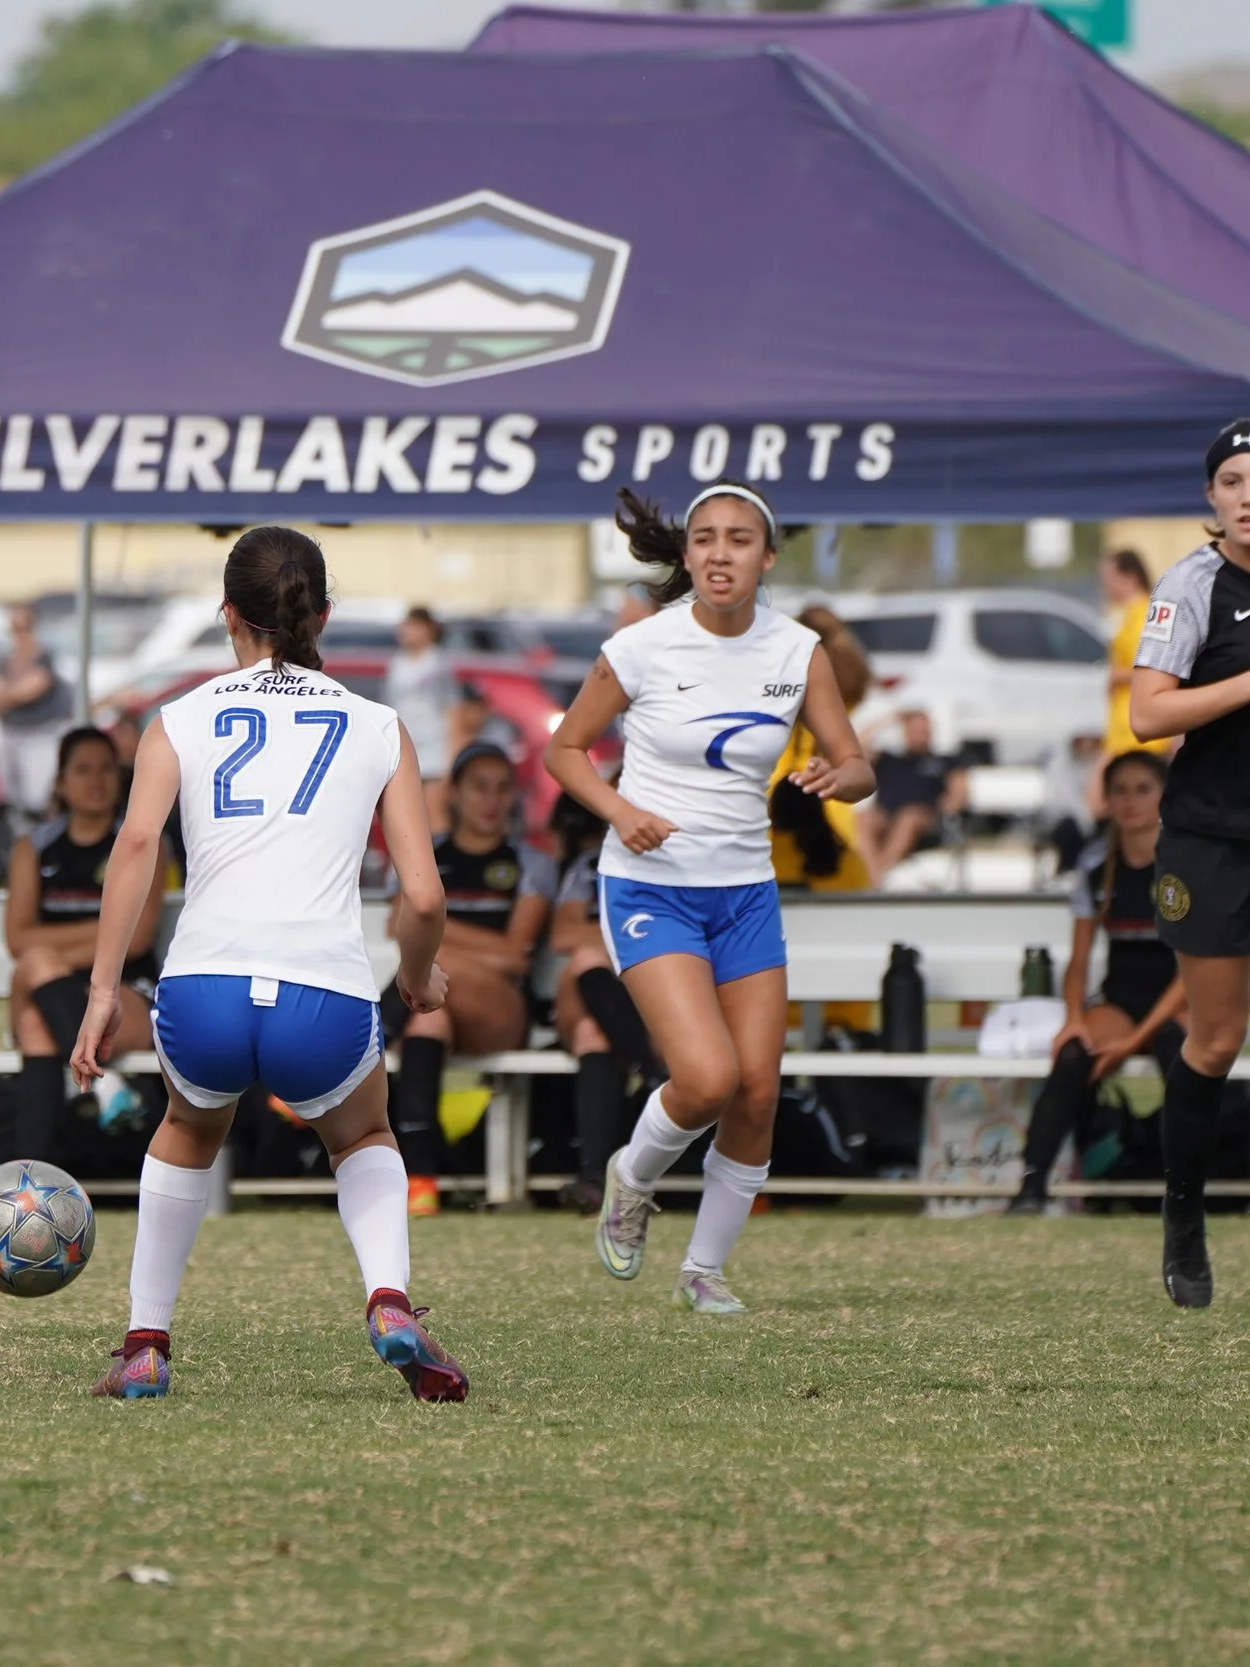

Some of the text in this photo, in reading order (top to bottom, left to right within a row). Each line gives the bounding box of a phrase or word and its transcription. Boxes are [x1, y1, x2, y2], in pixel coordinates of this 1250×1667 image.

[576, 423, 896, 483] SPORTS
[263, 675, 308, 685] SURF
[214, 683, 343, 697] LOS ANGELES
[762, 683, 805, 697] SURF
[213, 707, 349, 819] 27
